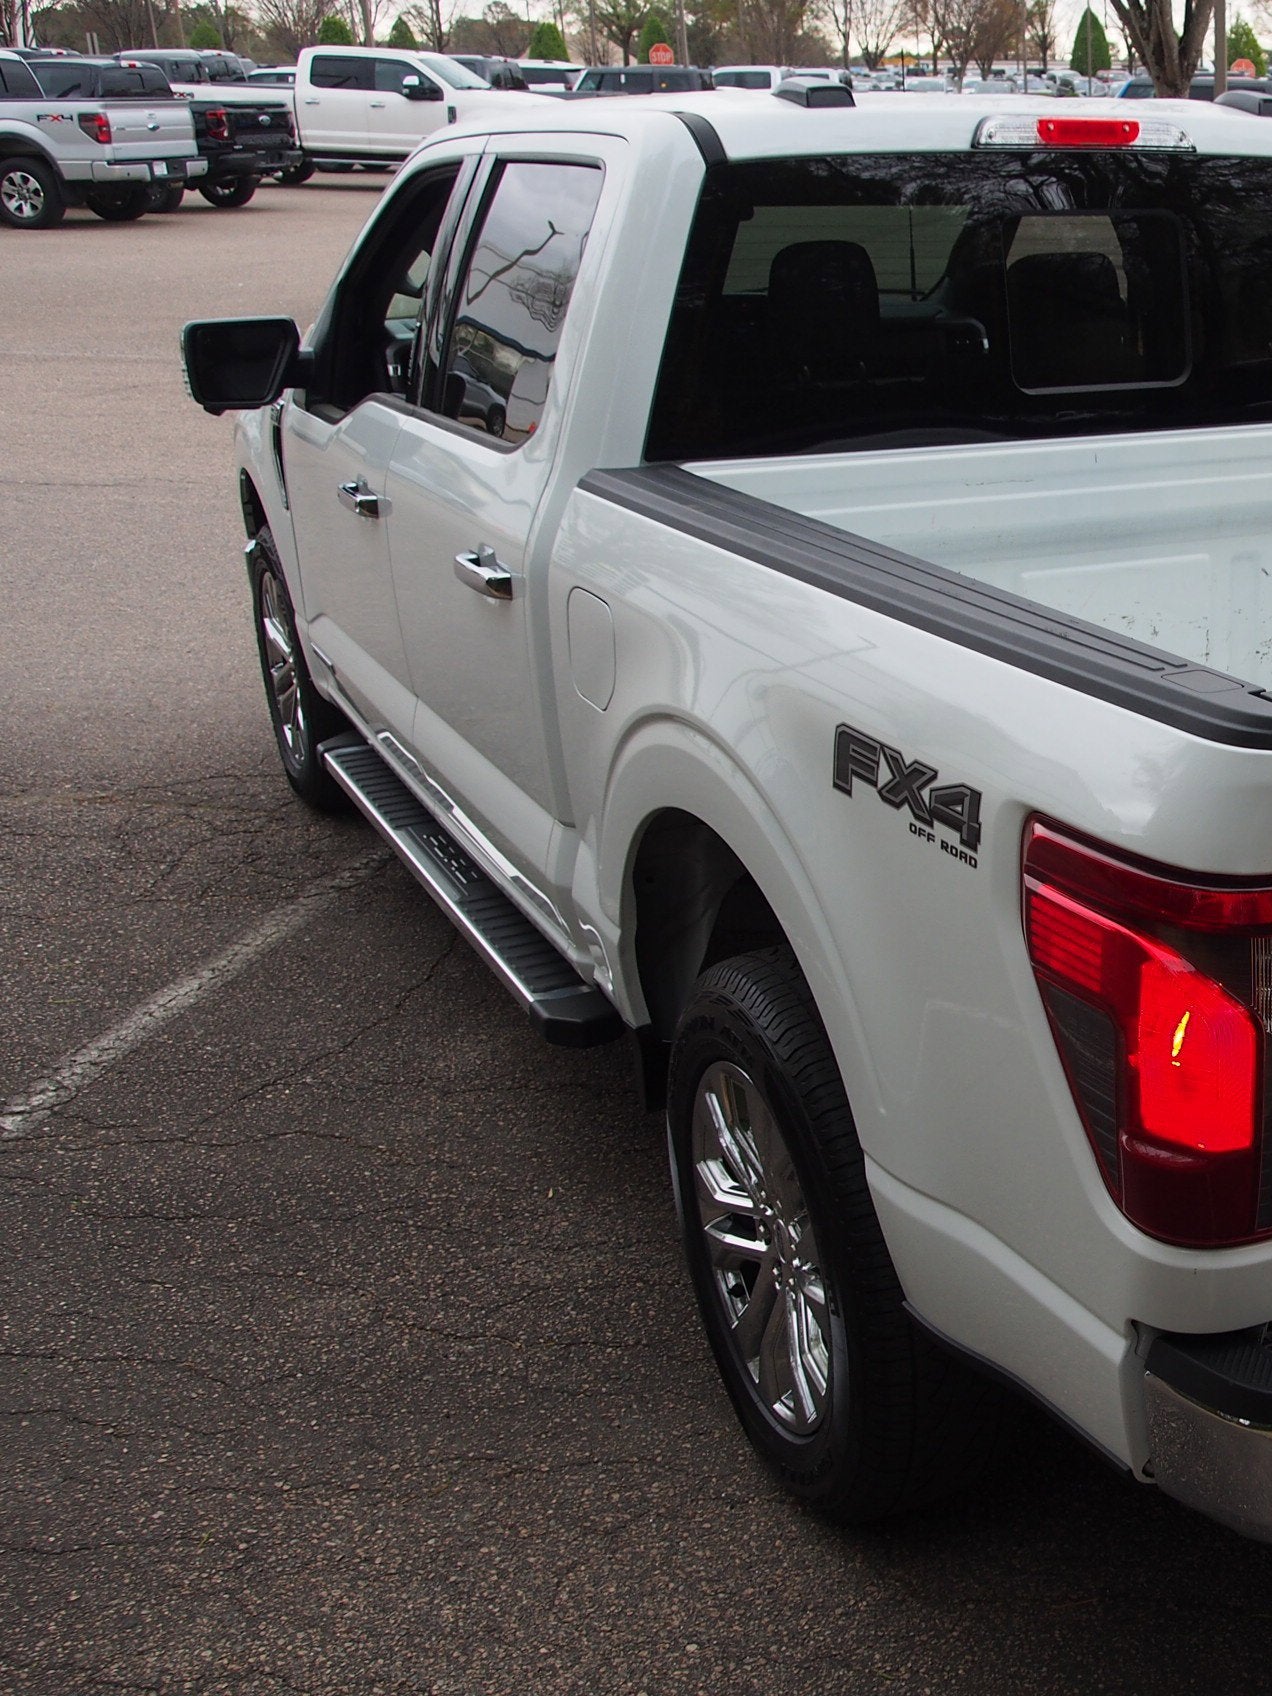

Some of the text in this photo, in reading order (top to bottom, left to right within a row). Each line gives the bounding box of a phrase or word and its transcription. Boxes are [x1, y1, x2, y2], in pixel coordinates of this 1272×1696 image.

[651, 51, 671, 62] STOP
[37, 114, 74, 122] FX4
[833, 722, 983, 854] FX4
[909, 822, 978, 869] OFF ROAD
